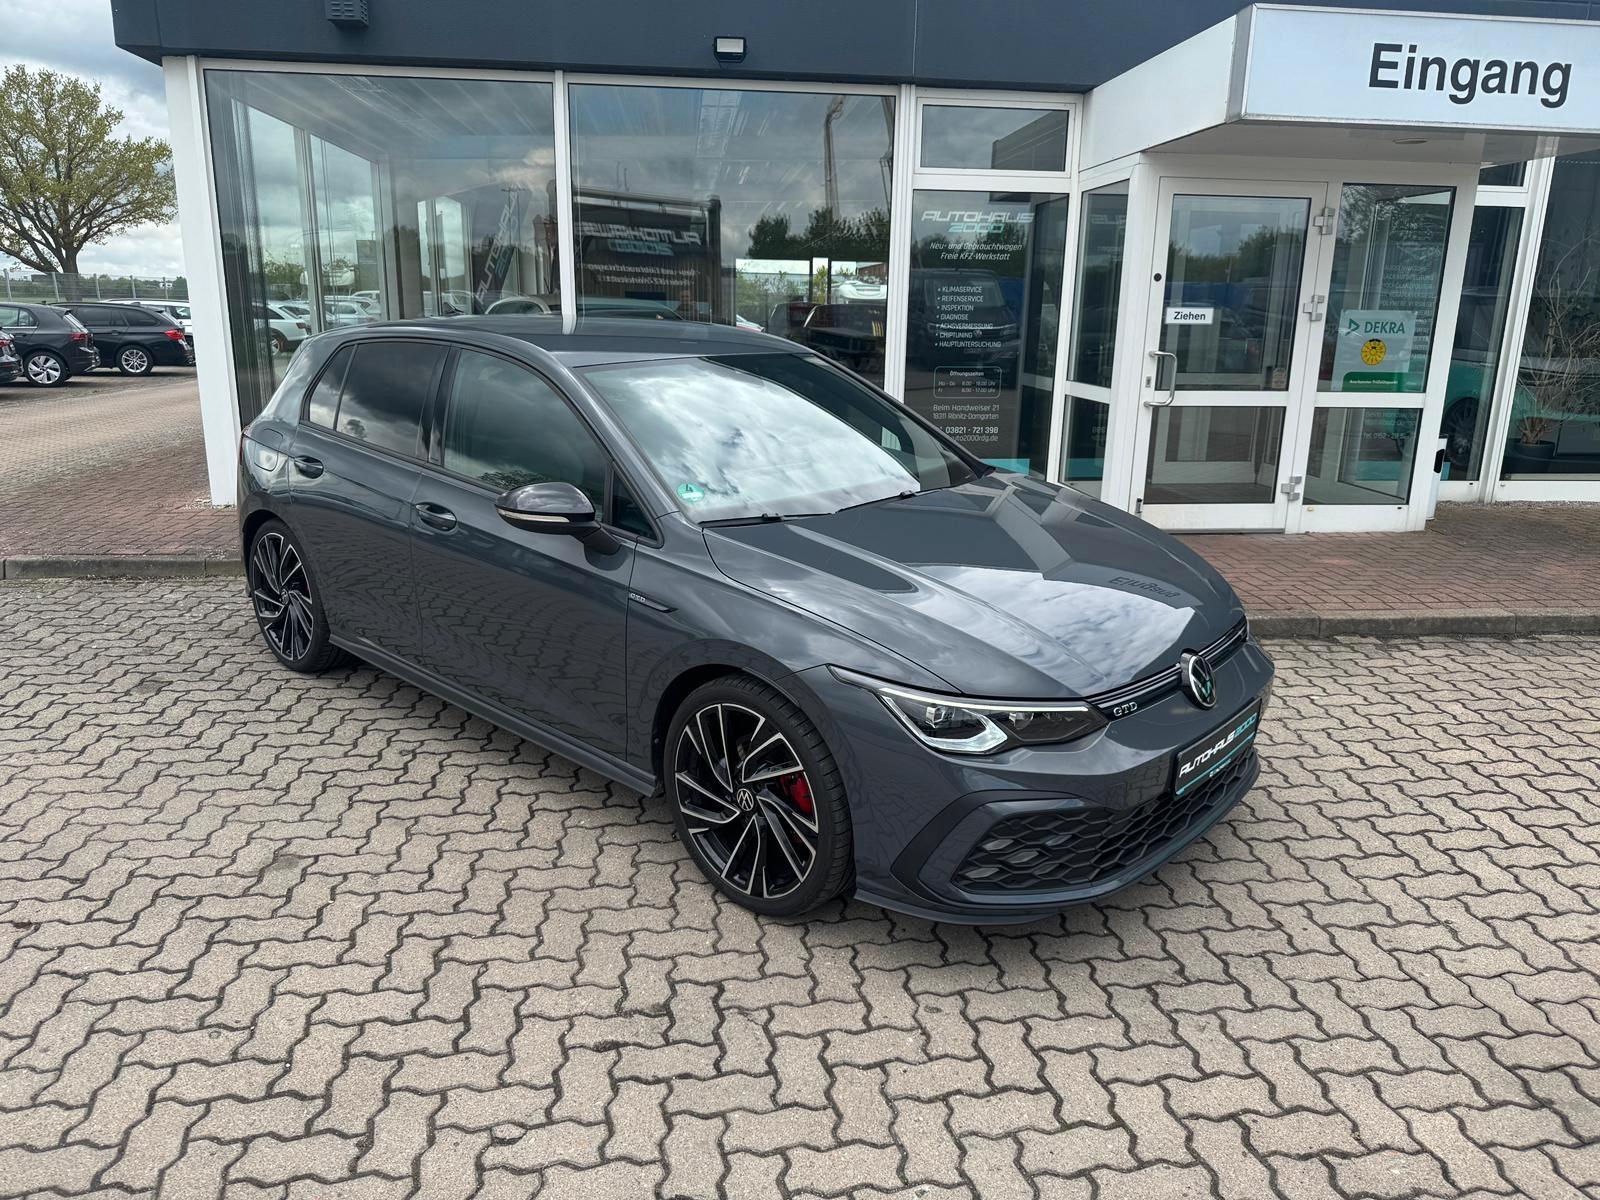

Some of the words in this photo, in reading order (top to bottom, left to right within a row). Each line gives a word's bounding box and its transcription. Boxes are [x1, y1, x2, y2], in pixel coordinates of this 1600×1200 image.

[1368, 42, 1572, 109] Eingang
[922, 211, 1035, 223] AUTOHAUS
[948, 222, 1005, 233] 2000
[930, 242, 947, 250] Neu-
[948, 242, 962, 250] und
[964, 243, 1022, 251] Gebrauchtwagen
[941, 252, 959, 260] Freie
[1174, 311, 1206, 320] Ziehen
[1364, 322, 1405, 334] DEKRA
[686, 484, 693, 492] 4
[1114, 701, 1138, 718] GTD
